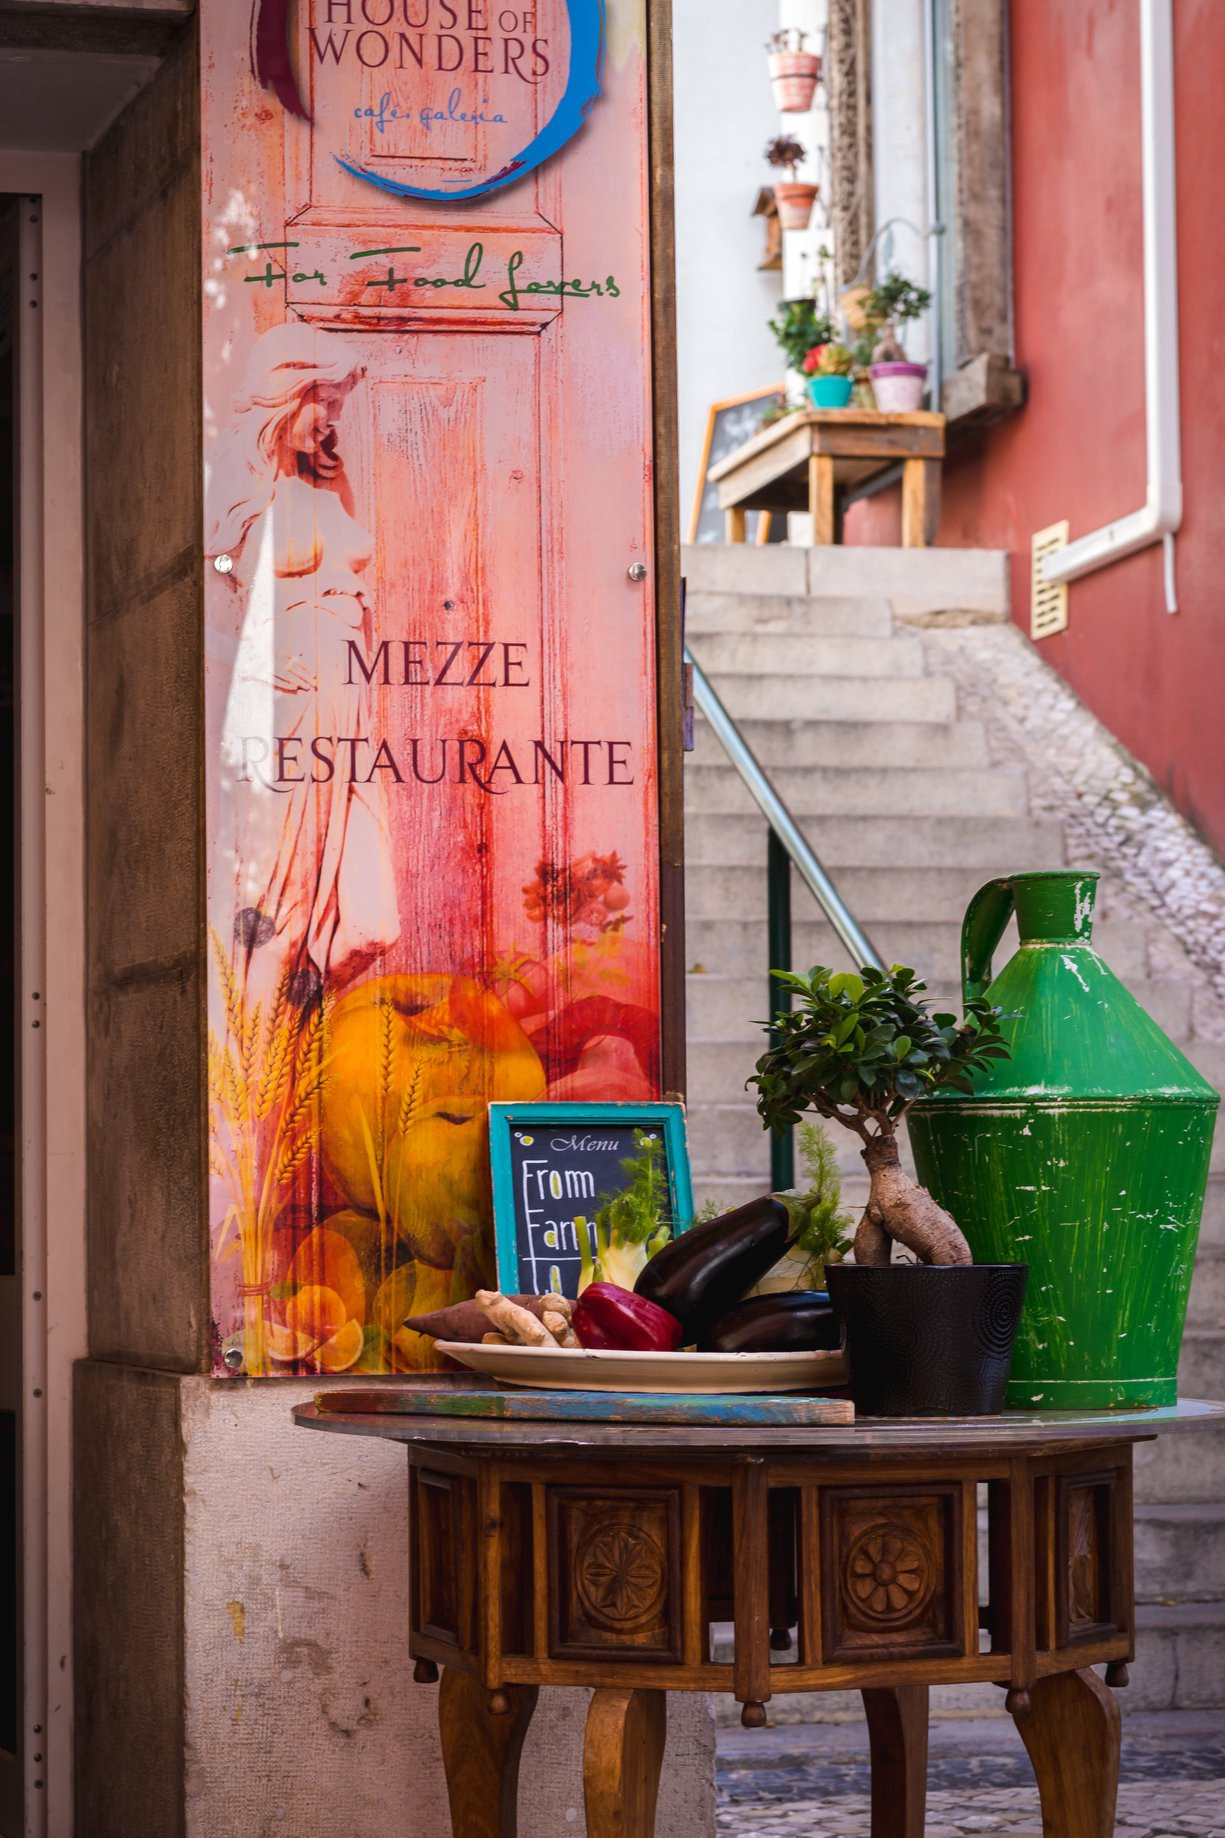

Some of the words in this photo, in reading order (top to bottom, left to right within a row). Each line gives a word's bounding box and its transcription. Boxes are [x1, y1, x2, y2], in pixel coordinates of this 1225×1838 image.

[323, 0, 488, 31] HOUSE
[498, 10, 536, 33] OF
[307, 27, 550, 84] WONDERS
[419, 87, 508, 131] galeria
[227, 242, 328, 288] For
[350, 242, 487, 292] Food
[499, 251, 621, 311] Lovers
[341, 639, 530, 687] MEZZE
[236, 735, 635, 795] RESTAURANTE
[550, 1134, 620, 1152] Menu
[522, 1159, 595, 1200] From
[525, 1208, 598, 1251] Farm
